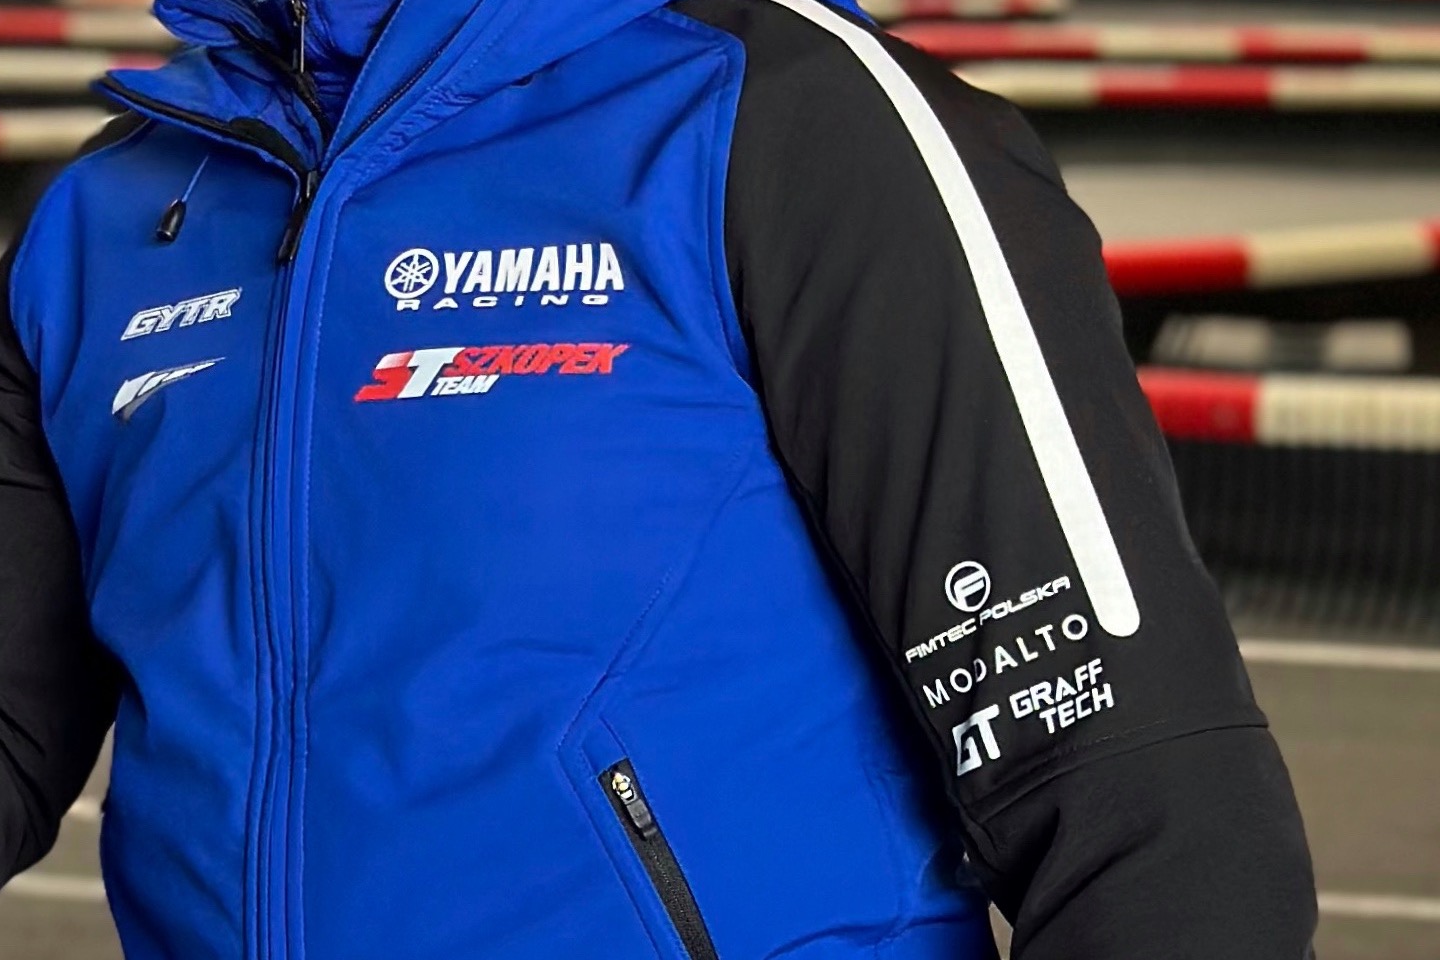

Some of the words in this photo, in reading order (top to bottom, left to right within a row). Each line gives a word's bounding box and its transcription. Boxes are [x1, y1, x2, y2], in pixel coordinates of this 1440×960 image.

[444, 242, 625, 294] YAMAHA
[120, 286, 243, 340] GYTR
[396, 293, 610, 312] RACING
[355, 346, 467, 402] ST
[444, 342, 630, 376] SZKOPEK
[430, 374, 500, 396] TEAM
[905, 617, 978, 664] FIMTEC
[979, 575, 1072, 626] POLSKA
[1009, 657, 1104, 720] GRAFF
[1039, 683, 1115, 734] TECH
[951, 703, 1002, 777] GT
